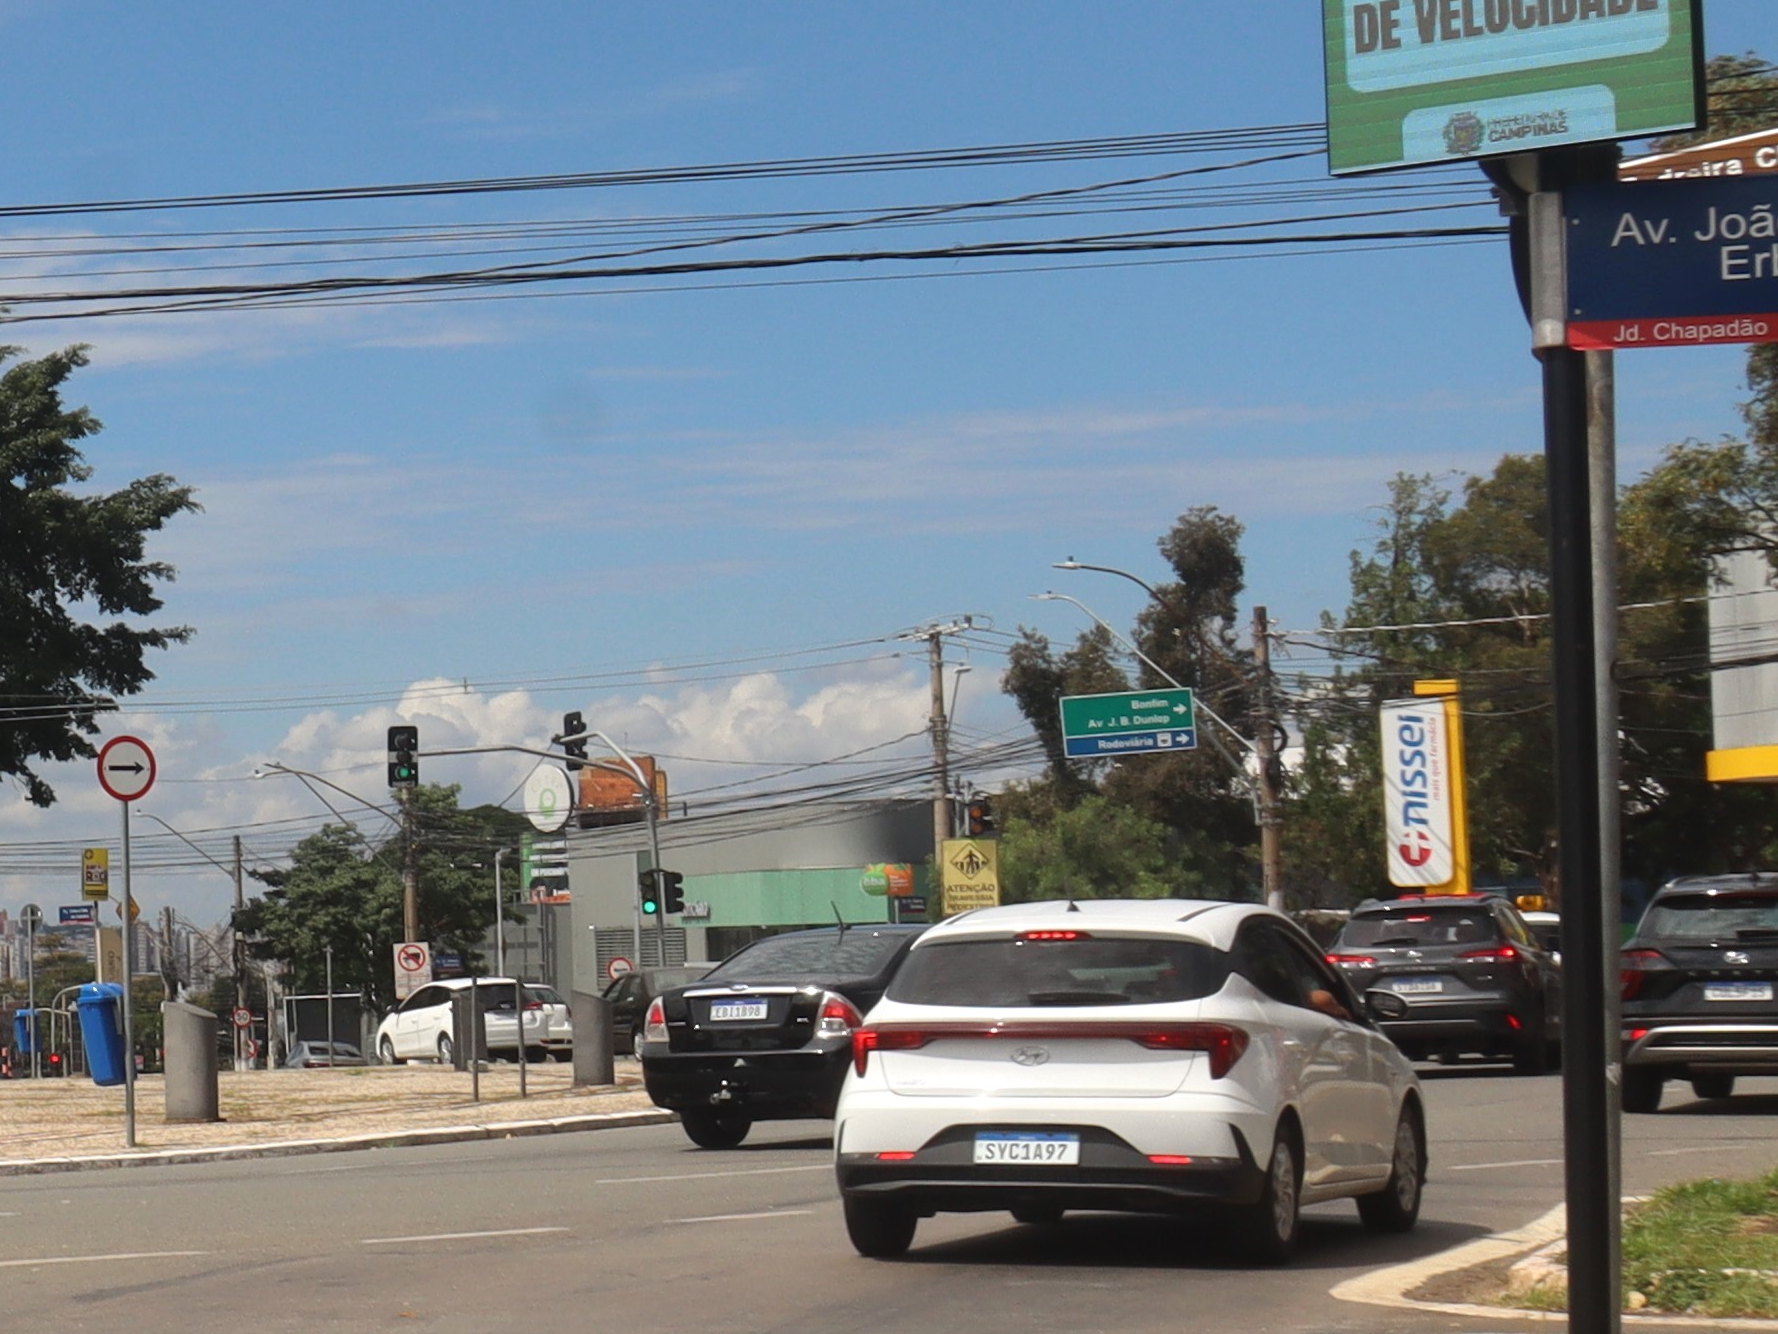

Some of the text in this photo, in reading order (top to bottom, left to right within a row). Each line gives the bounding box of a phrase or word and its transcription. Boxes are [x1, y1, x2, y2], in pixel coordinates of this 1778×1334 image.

[1487, 120, 1569, 142] CAMPINAS
[1754, 146, 1778, 168] C
[1611, 203, 1778, 247] Av. Joã
[1613, 319, 1768, 342] Jd. Chapadão
[1396, 714, 1430, 827] nissei
[947, 882, 996, 894] ATENÇÃO
[985, 1142, 1068, 1160] SYC1A97
